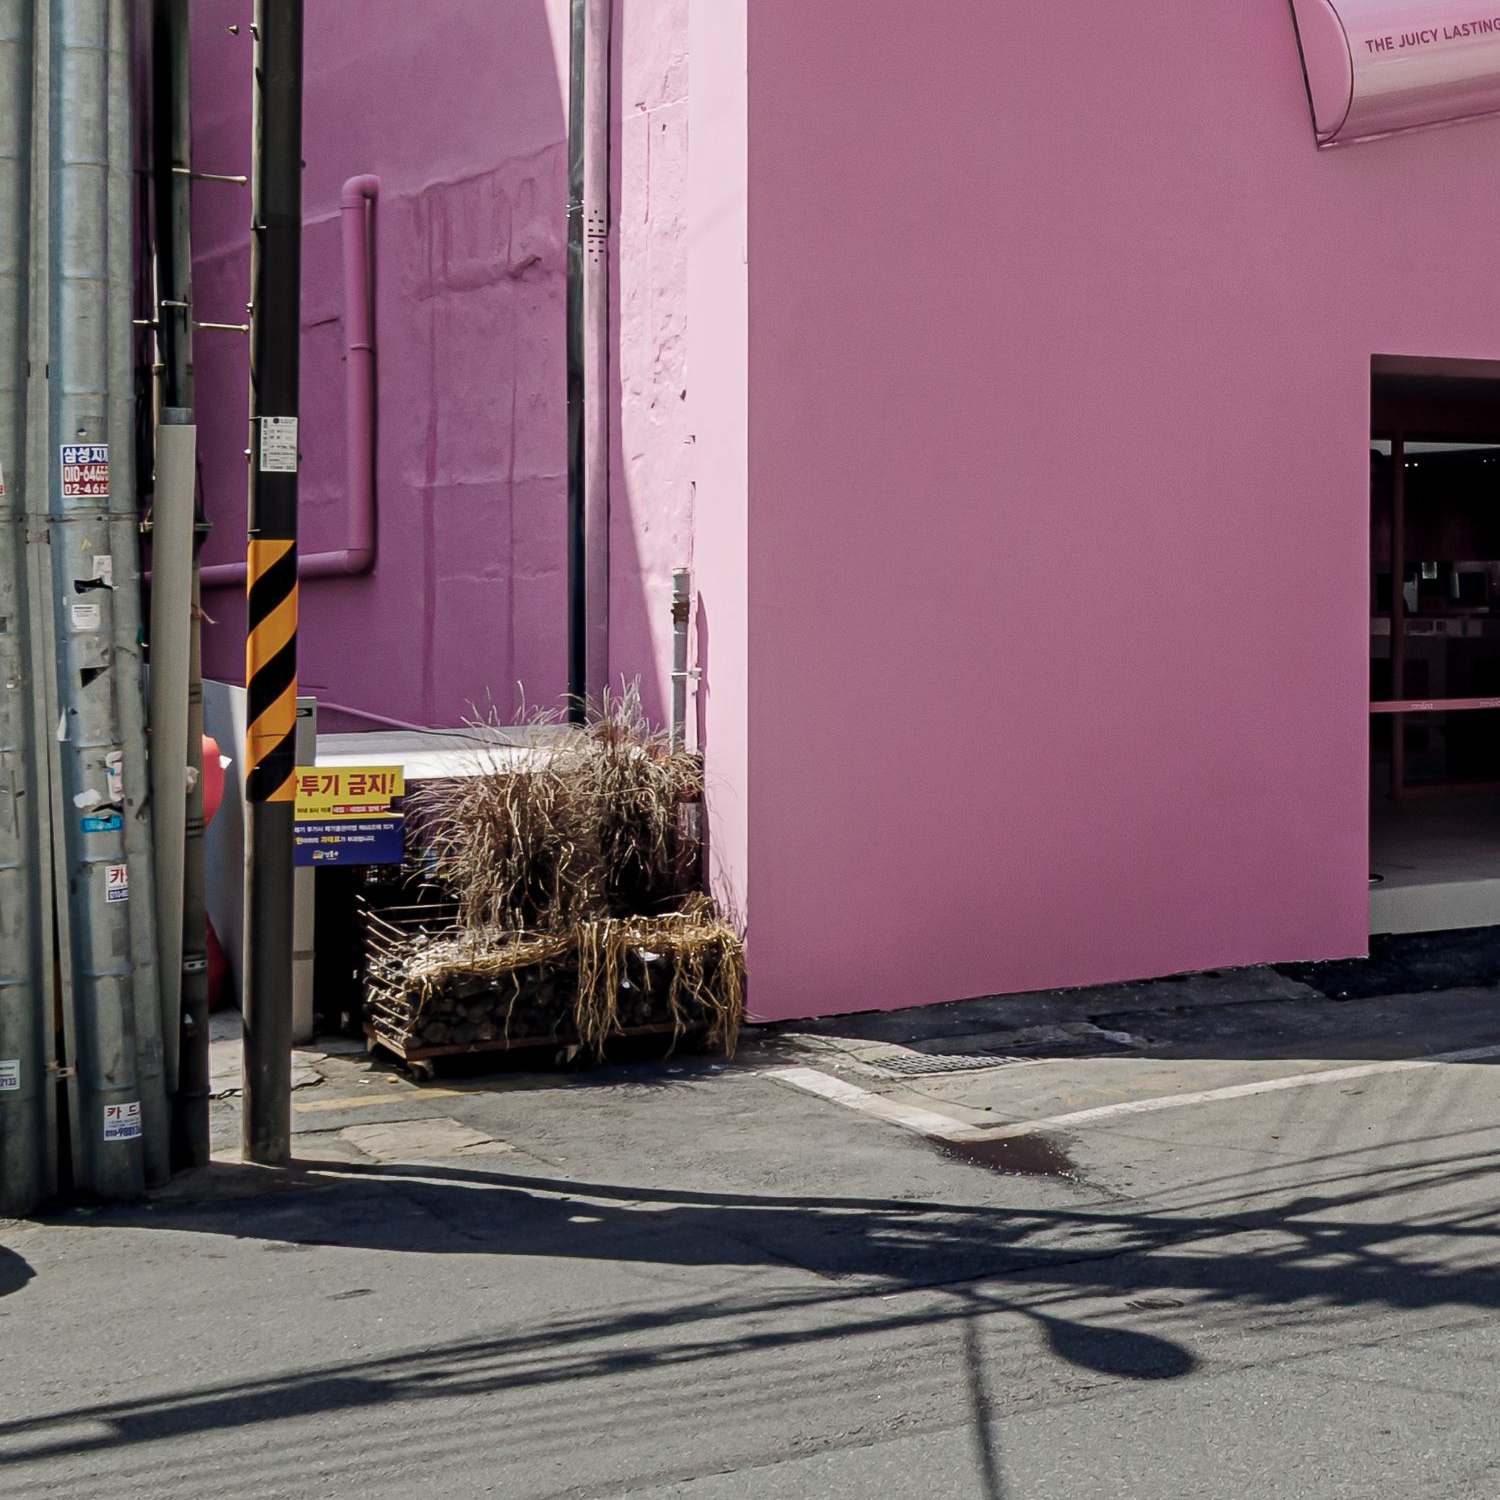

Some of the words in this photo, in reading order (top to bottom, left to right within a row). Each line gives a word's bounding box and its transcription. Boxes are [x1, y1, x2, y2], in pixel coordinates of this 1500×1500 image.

[1365, 37, 1395, 53] THE
[1399, 28, 1438, 48] JUICY
[296, 774, 340, 797] 투기
[347, 773, 396, 796] 금지!
[110, 868, 128, 884] 카
